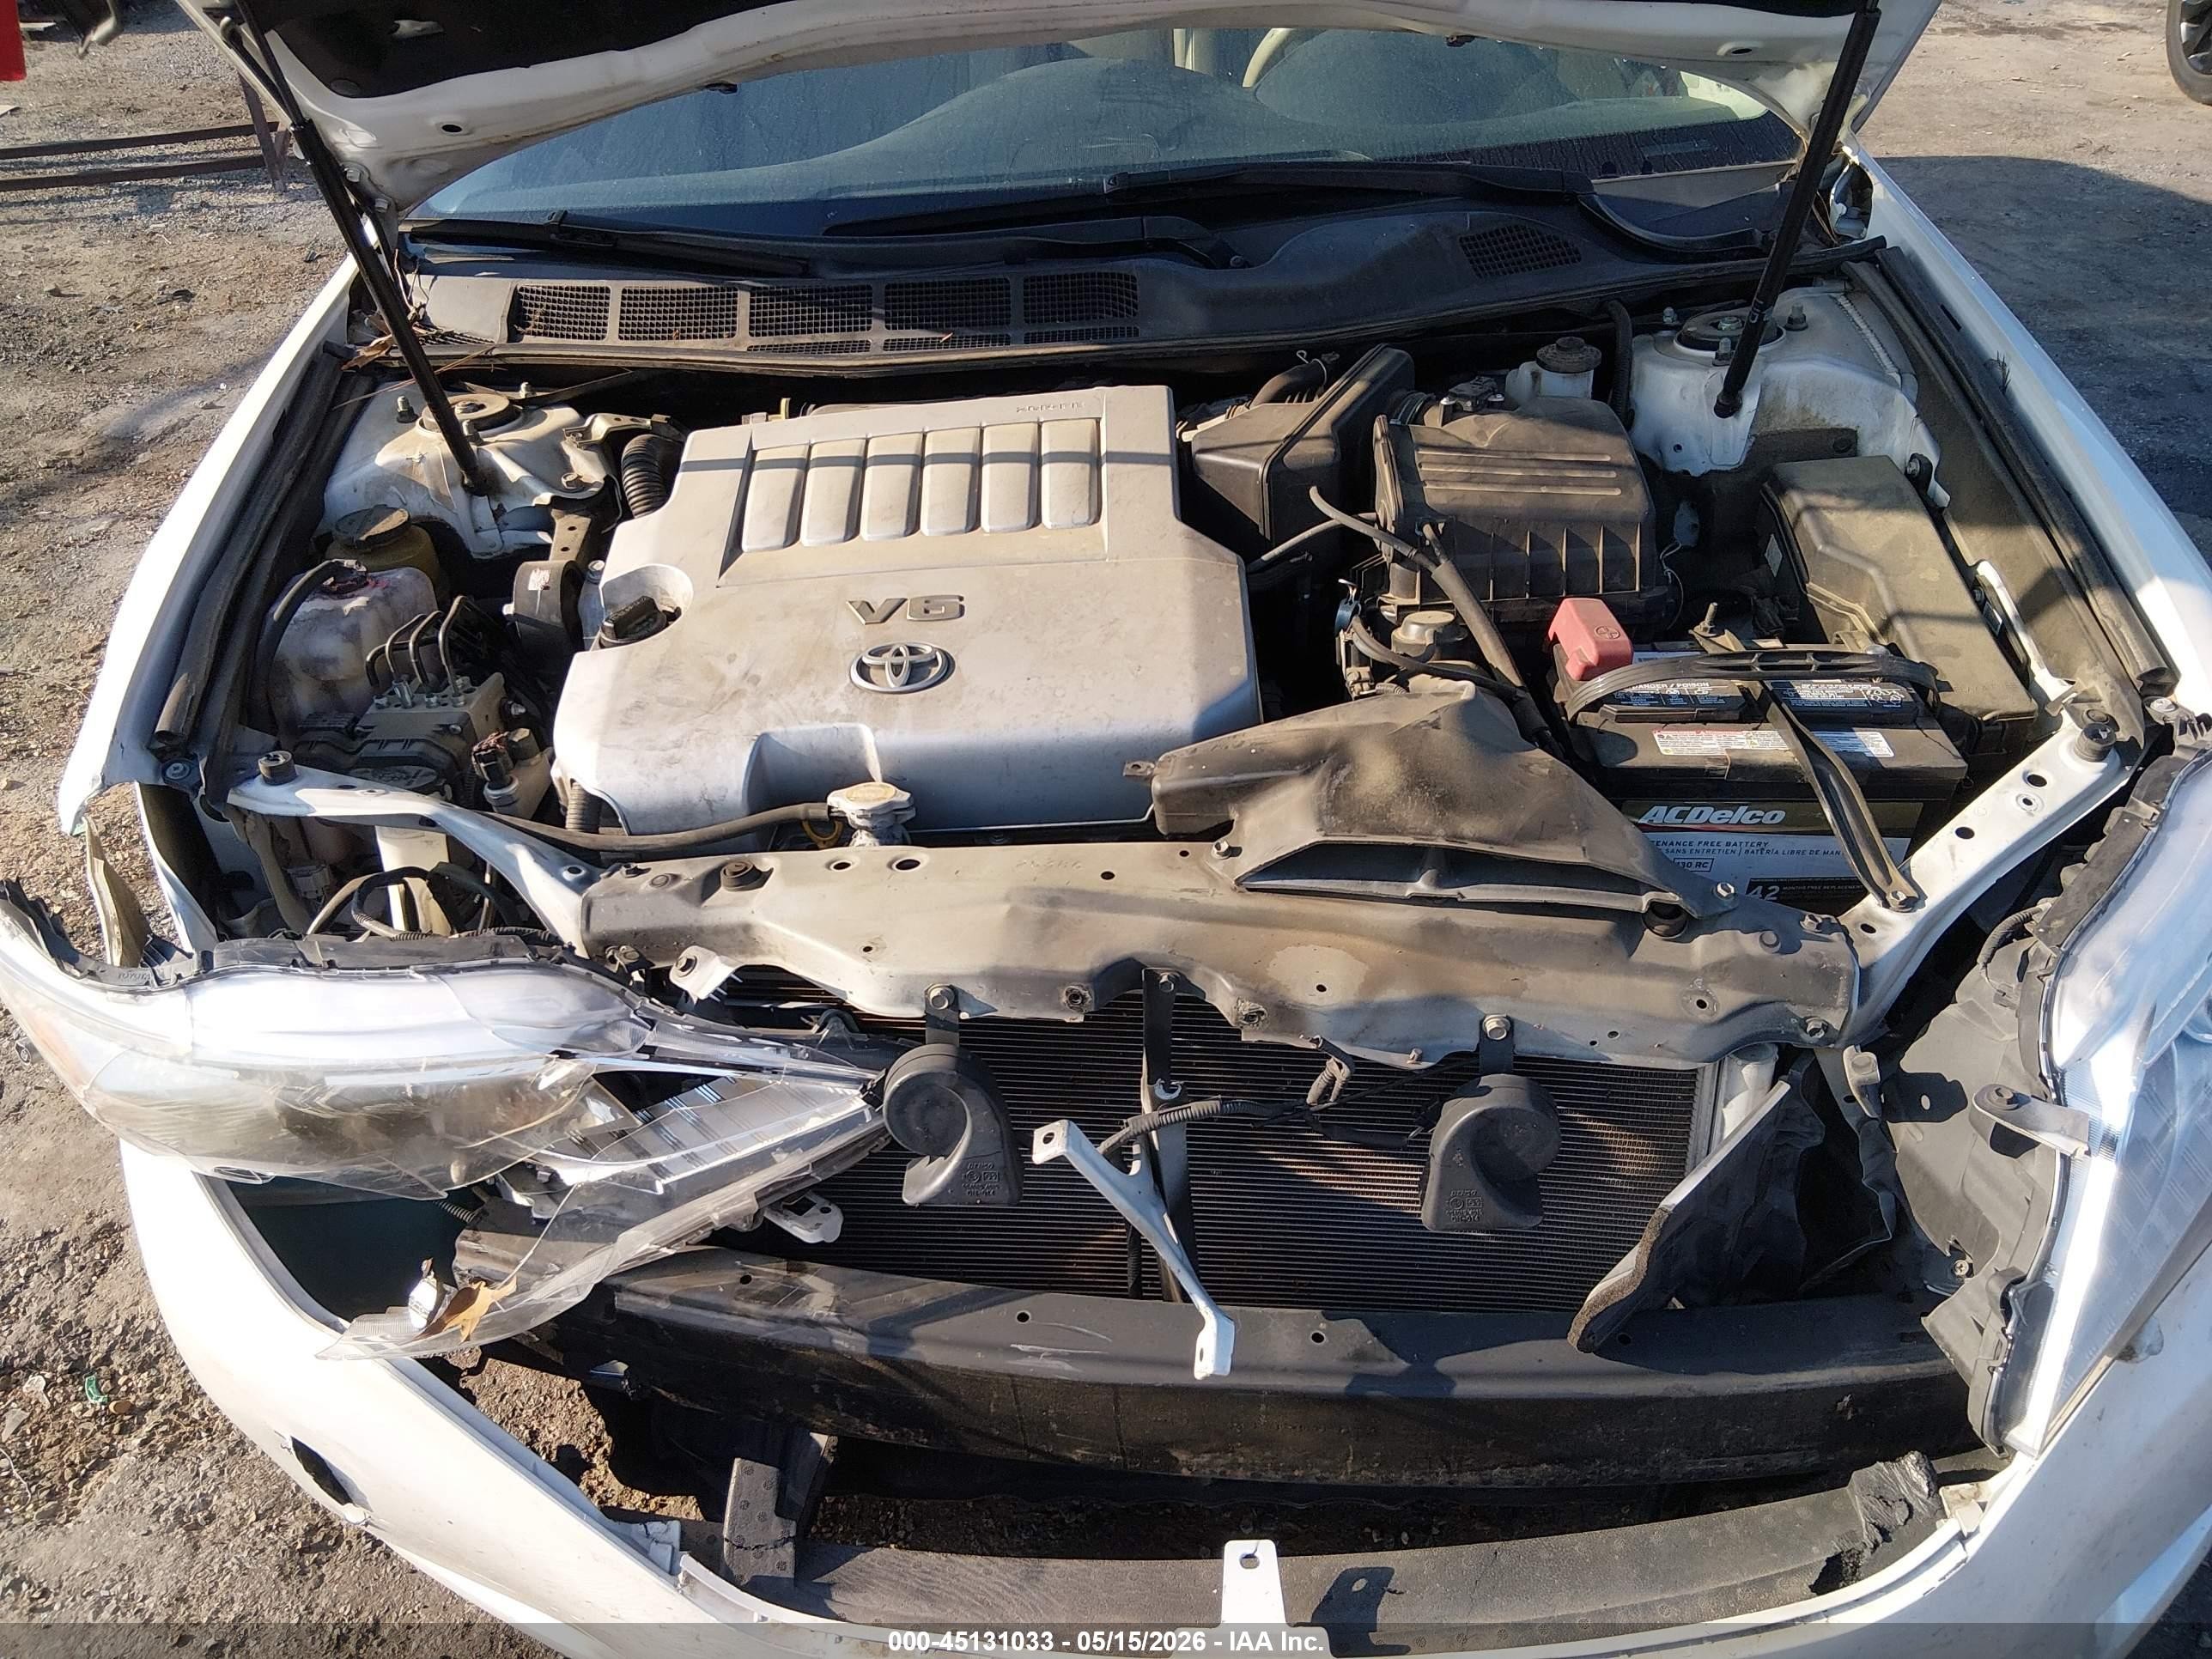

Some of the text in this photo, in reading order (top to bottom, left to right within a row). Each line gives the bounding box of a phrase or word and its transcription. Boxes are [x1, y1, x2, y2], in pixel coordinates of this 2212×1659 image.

[845, 594, 966, 626] V6
[1638, 805, 1786, 824] ACDelco
[1748, 885, 1780, 901] 42
